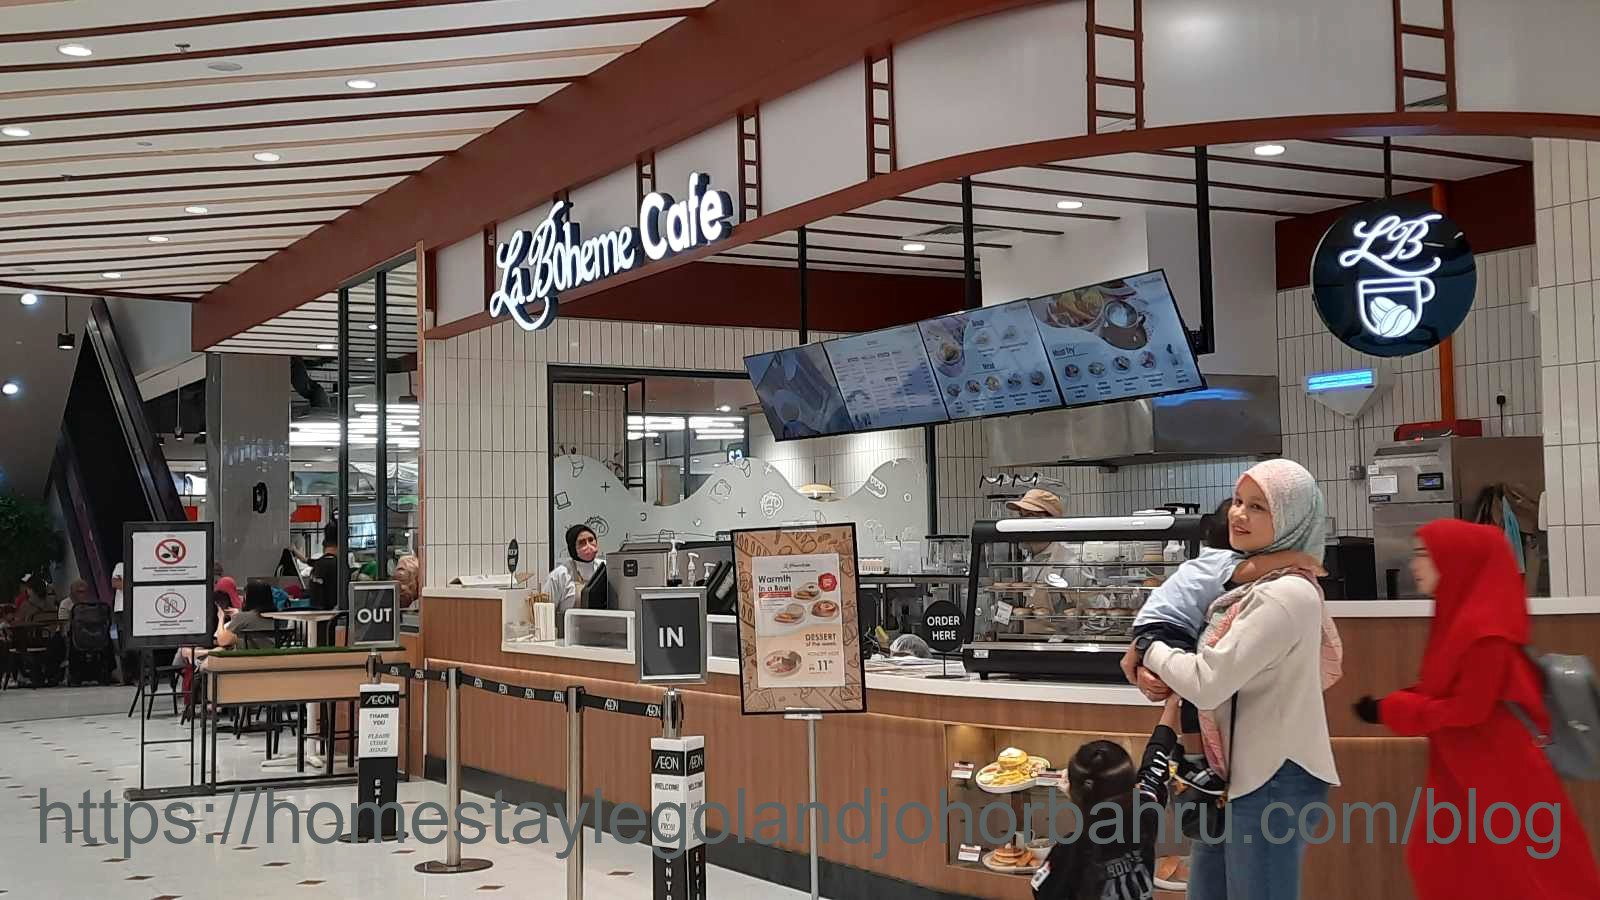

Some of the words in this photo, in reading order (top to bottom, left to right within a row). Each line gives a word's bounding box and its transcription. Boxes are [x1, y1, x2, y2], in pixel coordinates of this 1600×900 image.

[1338, 214, 1443, 277] LB
[528, 200, 635, 303] Boheme
[758, 575, 792, 584] Warmth
[357, 607, 392, 624] OUT
[926, 615, 961, 626] ORDER
[658, 626, 684, 648] IN
[805, 632, 836, 641] DESSERT
[931, 630, 957, 641] HERE
[654, 782, 680, 792] WELCOME
